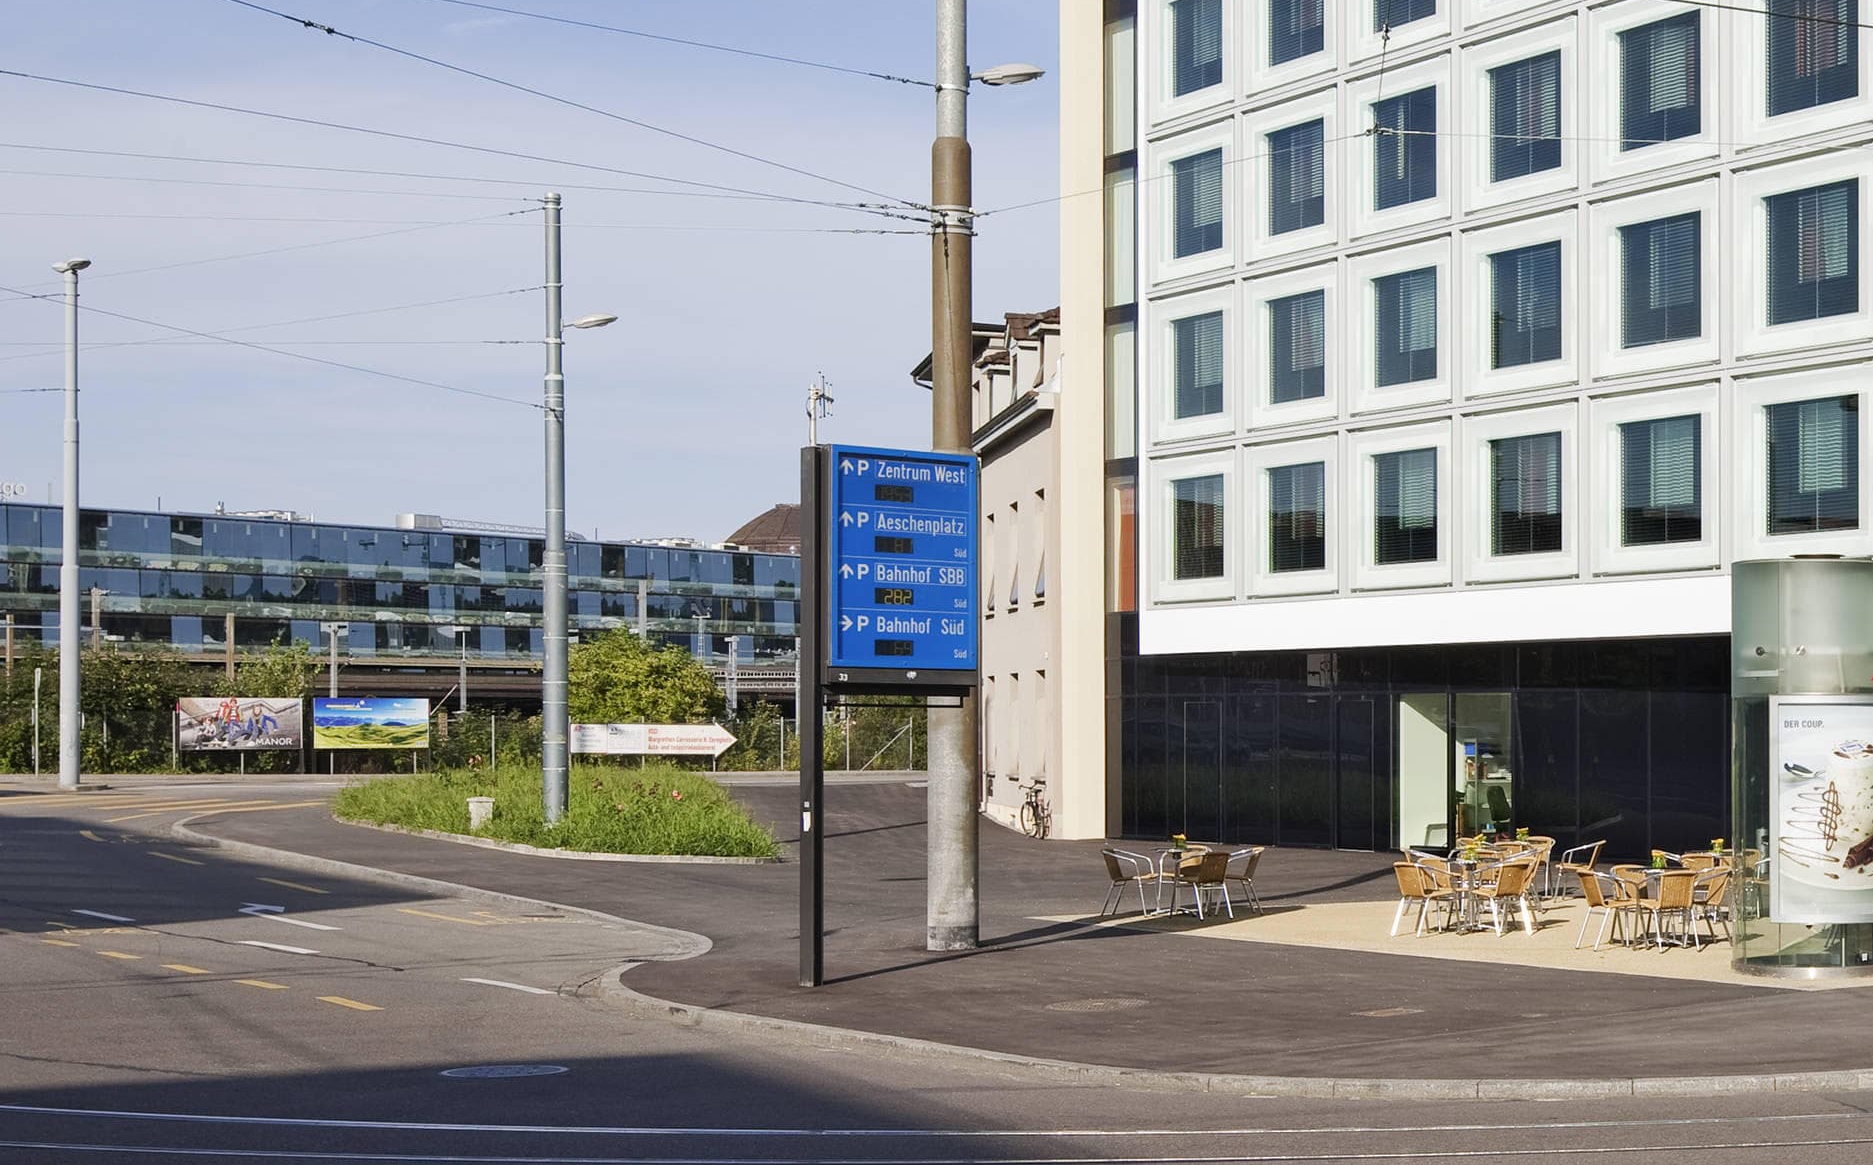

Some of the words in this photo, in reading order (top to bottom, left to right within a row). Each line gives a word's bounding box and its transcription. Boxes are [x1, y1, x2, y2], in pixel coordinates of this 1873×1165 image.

[857, 459, 869, 476] P
[878, 461, 931, 481] Zentrum
[935, 466, 965, 484] West
[857, 511, 869, 528] P
[877, 513, 964, 536] Aeschenplatz
[857, 563, 869, 580] P
[877, 564, 931, 583] Bahnhof
[939, 568, 964, 585] SBB
[884, 589, 912, 605] 282
[953, 599, 967, 608] Süd
[857, 615, 869, 632] P
[877, 616, 931, 634] Bahnhof
[941, 618, 964, 635] Süd
[1783, 720, 1800, 728] DER
[1801, 720, 1824, 728] COUP.
